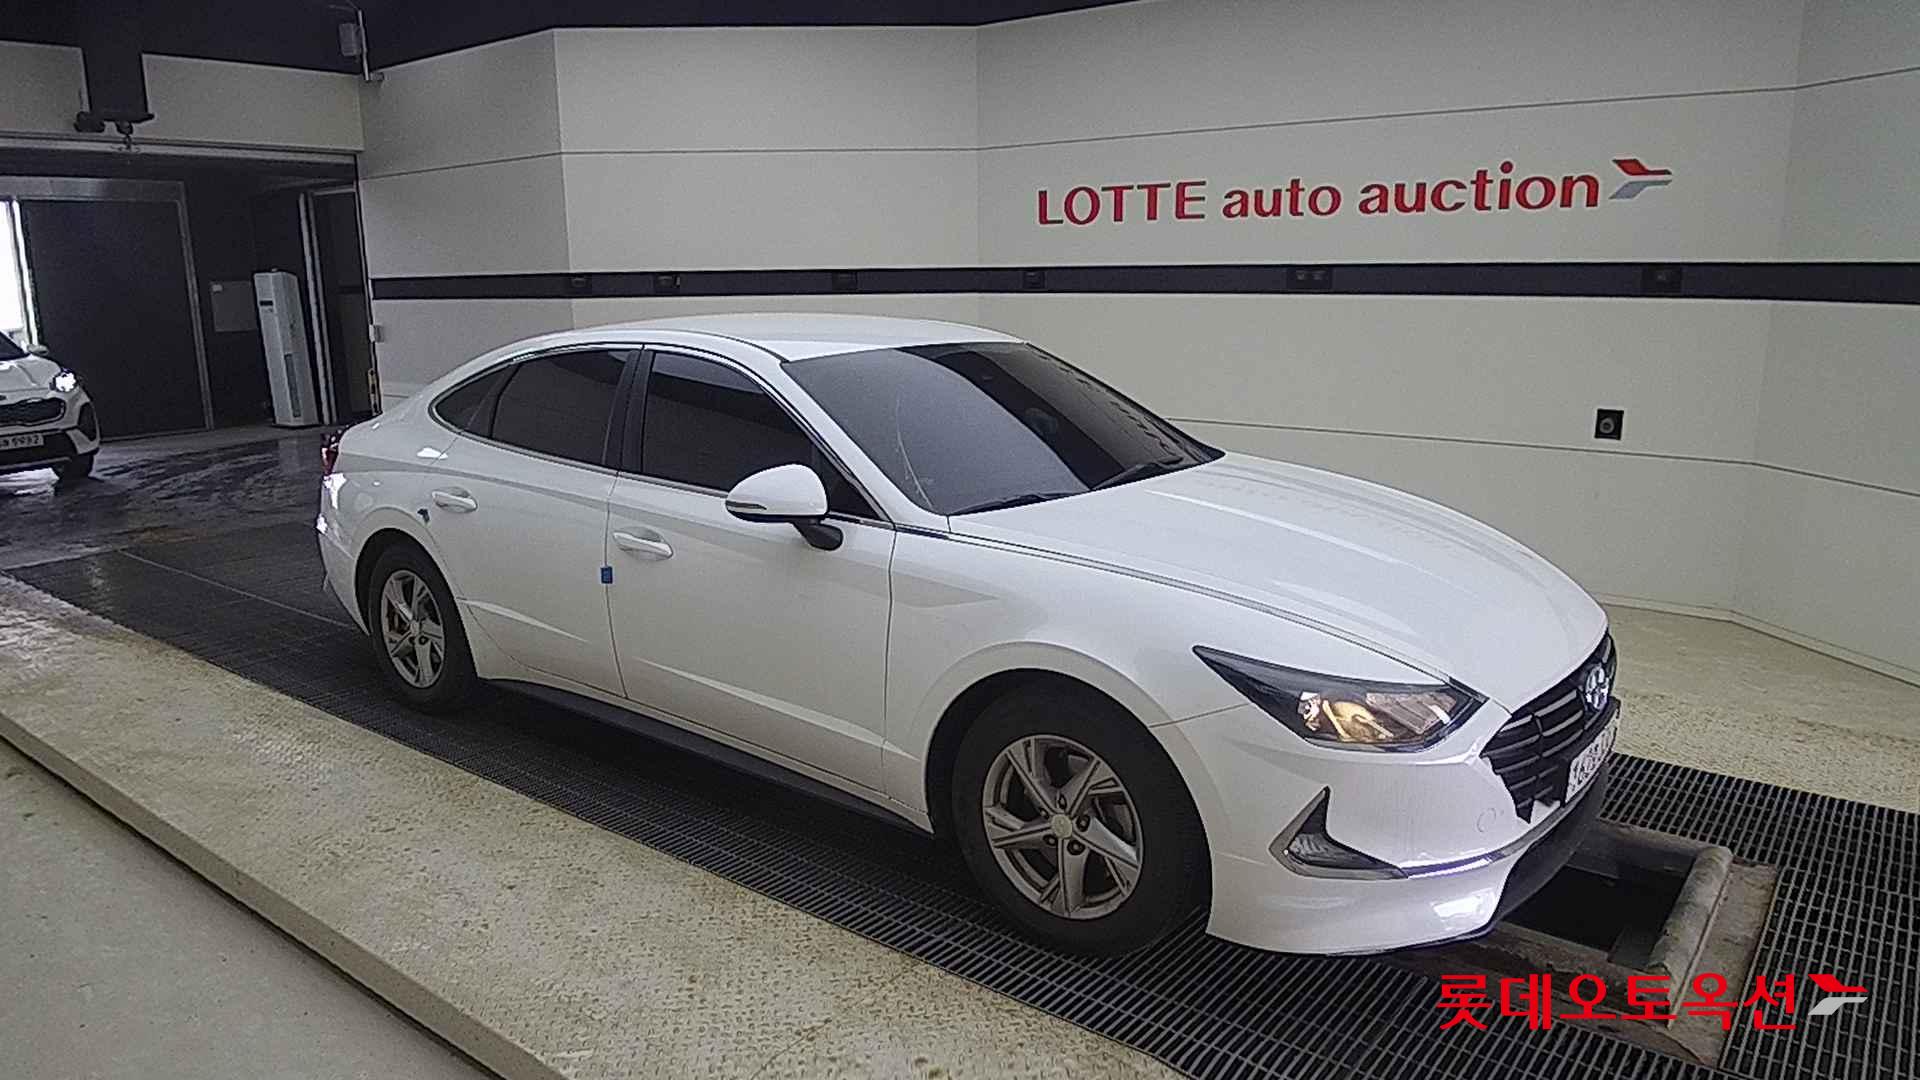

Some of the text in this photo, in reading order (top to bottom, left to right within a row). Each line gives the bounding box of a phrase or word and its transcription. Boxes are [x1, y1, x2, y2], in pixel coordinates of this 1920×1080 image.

[1037, 161, 1600, 226] LOTTE auto auction
